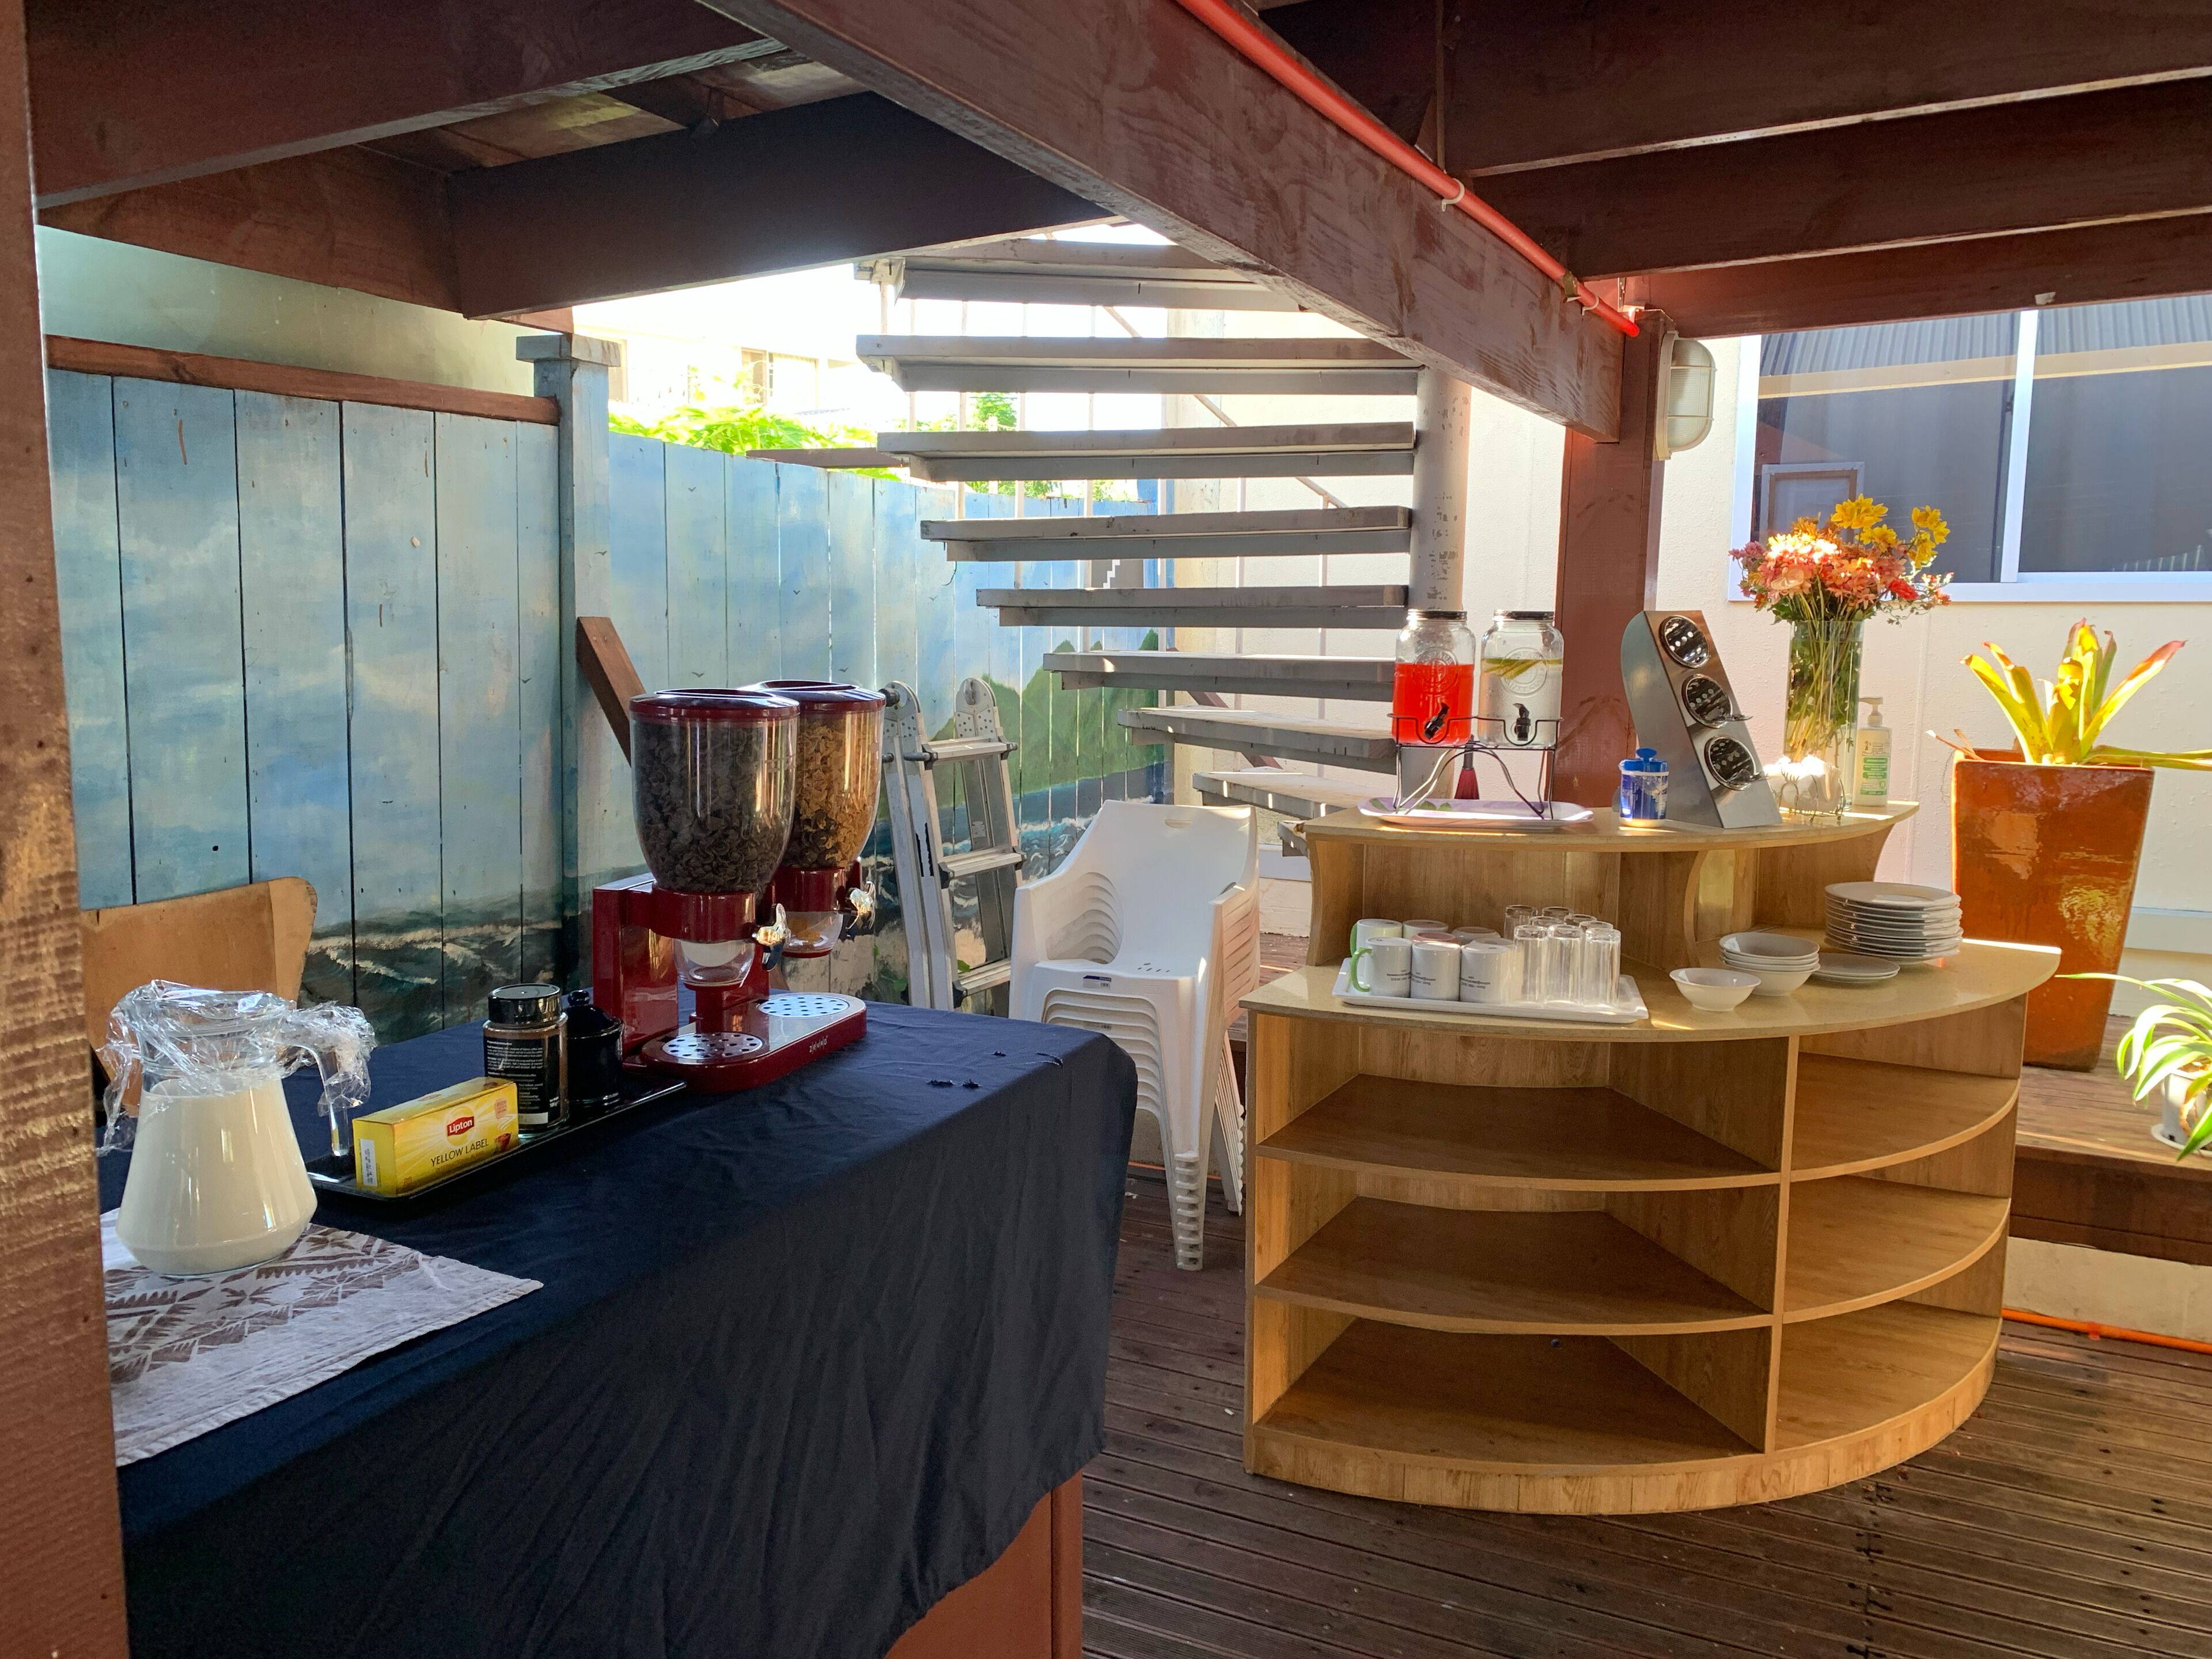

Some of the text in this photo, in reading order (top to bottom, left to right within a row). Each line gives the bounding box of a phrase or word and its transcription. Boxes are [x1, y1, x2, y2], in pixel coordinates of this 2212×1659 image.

[449, 1119, 472, 1134] Lipton
[430, 1146, 464, 1166] YELLOW
[465, 1138, 489, 1154] LABEL
